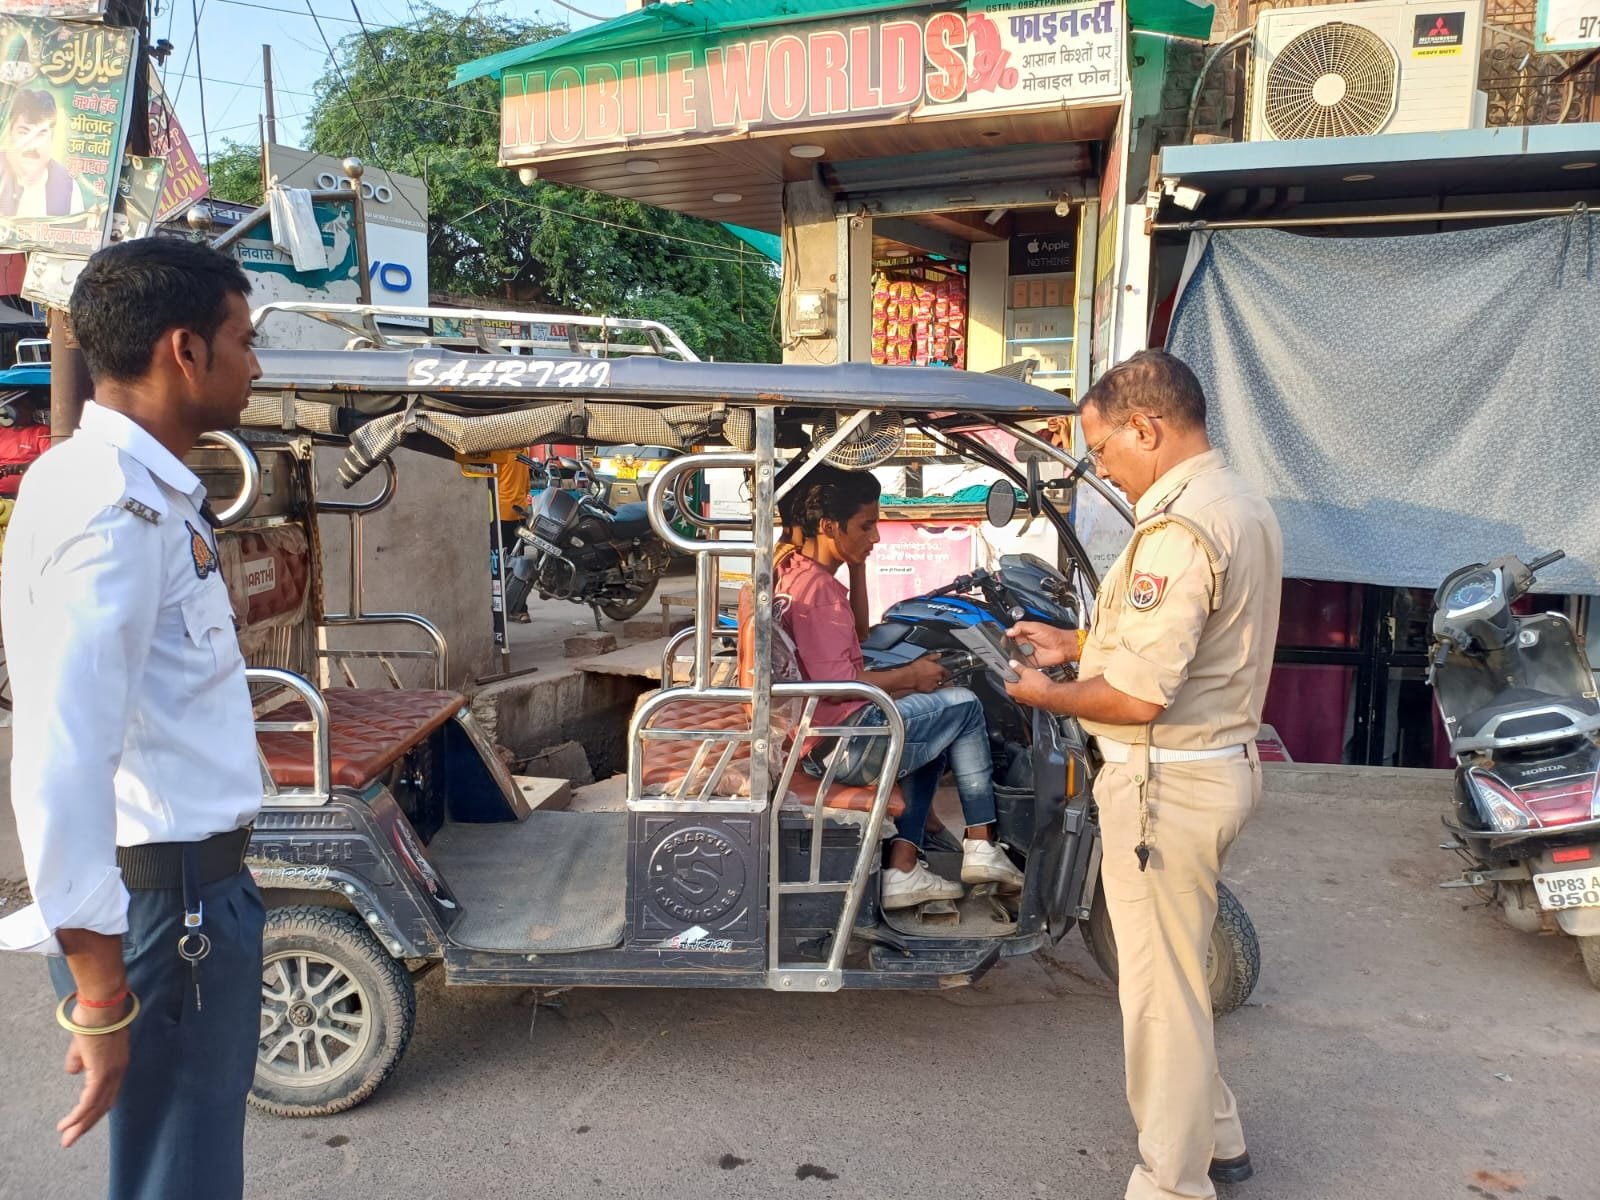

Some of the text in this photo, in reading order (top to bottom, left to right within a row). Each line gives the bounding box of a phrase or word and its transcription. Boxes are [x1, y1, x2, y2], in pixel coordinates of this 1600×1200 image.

[1008, 0, 1115, 45] फाइनन्स
[1022, 41, 1112, 69] आसान किश्तों पर
[1022, 65, 1112, 92] मोबाइल फोन
[502, 50, 697, 147] MOBILE
[1041, 241, 1070, 252] Apple
[1027, 256, 1071, 267] NOTHING
[408, 358, 611, 388] SAARTHI
[246, 567, 274, 588] ARTHI
[1521, 764, 1567, 777] HONDA
[1546, 877, 1587, 894] UP83
